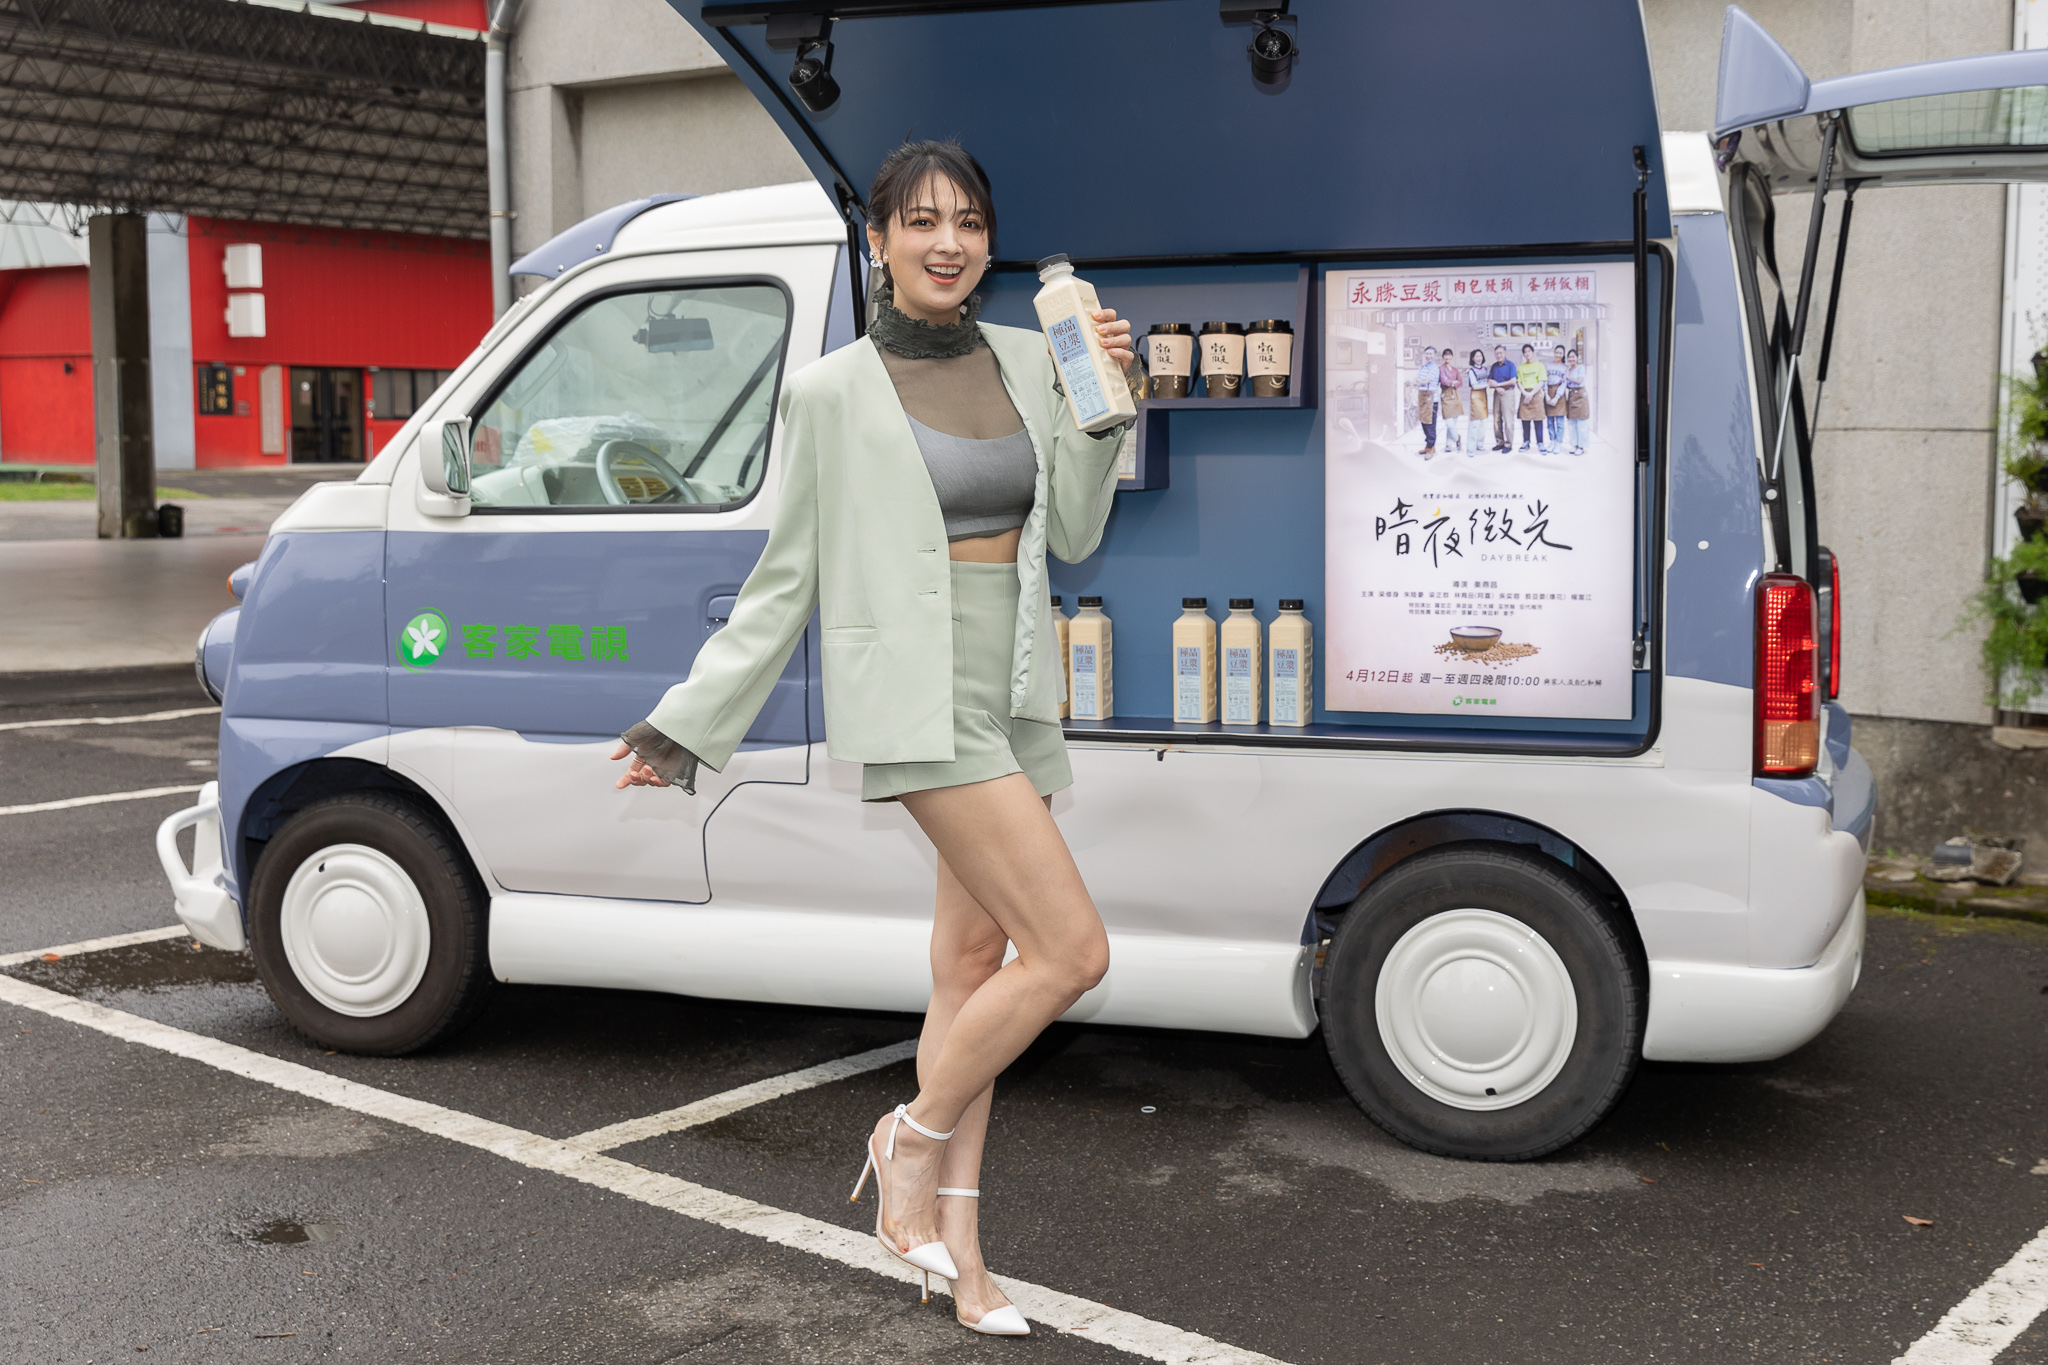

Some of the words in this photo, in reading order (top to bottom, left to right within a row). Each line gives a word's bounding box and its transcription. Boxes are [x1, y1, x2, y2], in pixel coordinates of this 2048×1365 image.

[1352, 281, 1443, 305] 永勝豆漿
[1454, 278, 1514, 294] 肉包饅頭
[1527, 276, 1590, 292] 蛋餅飯糰
[1052, 319, 1076, 340] 極品
[1057, 332, 1081, 352] 豆漿
[1376, 497, 1573, 568] 暗夜微光
[1481, 554, 1548, 562] DAYBREAK
[1452, 580, 1468, 588] 導演
[462, 623, 630, 662] 客家電視
[1346, 669, 1413, 683] 4月12日起
[1419, 672, 1540, 686] 週一至週四晚間10:00
